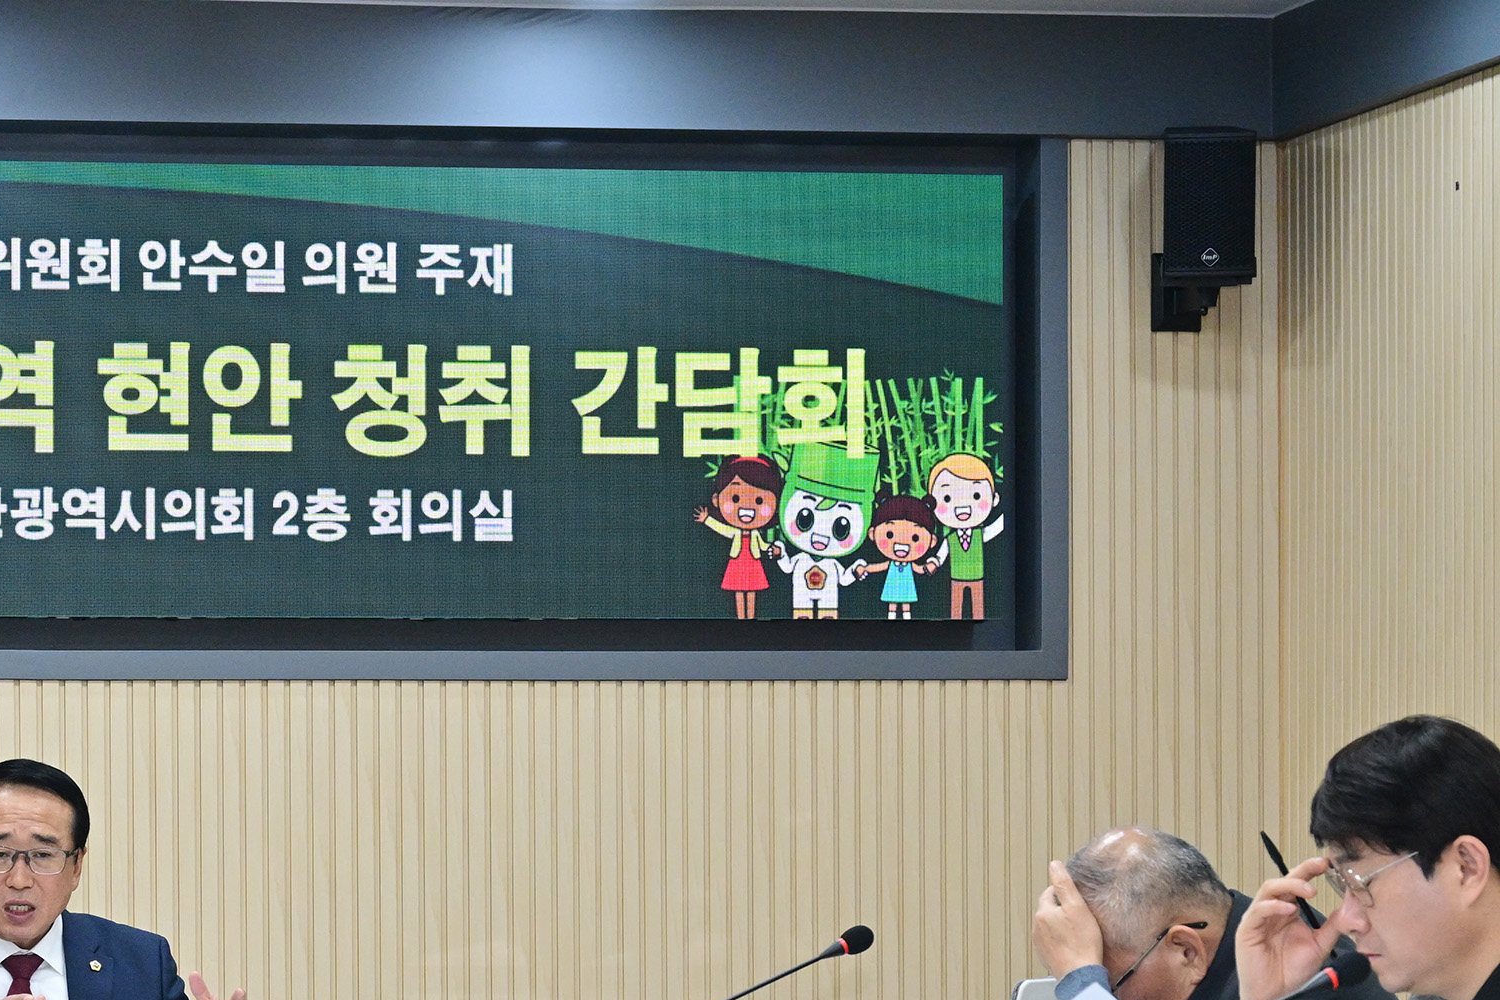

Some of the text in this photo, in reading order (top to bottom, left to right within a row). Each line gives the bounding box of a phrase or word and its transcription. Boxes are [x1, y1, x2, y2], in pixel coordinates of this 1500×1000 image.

[139, 239, 286, 293] 안수일
[303, 241, 398, 295] 의원
[416, 243, 515, 296] 주재
[96, 341, 303, 453] 현안
[331, 343, 532, 458] 청취
[571, 346, 866, 459] 간담회
[271, 489, 352, 543] 2층
[368, 488, 515, 543] 회의실
